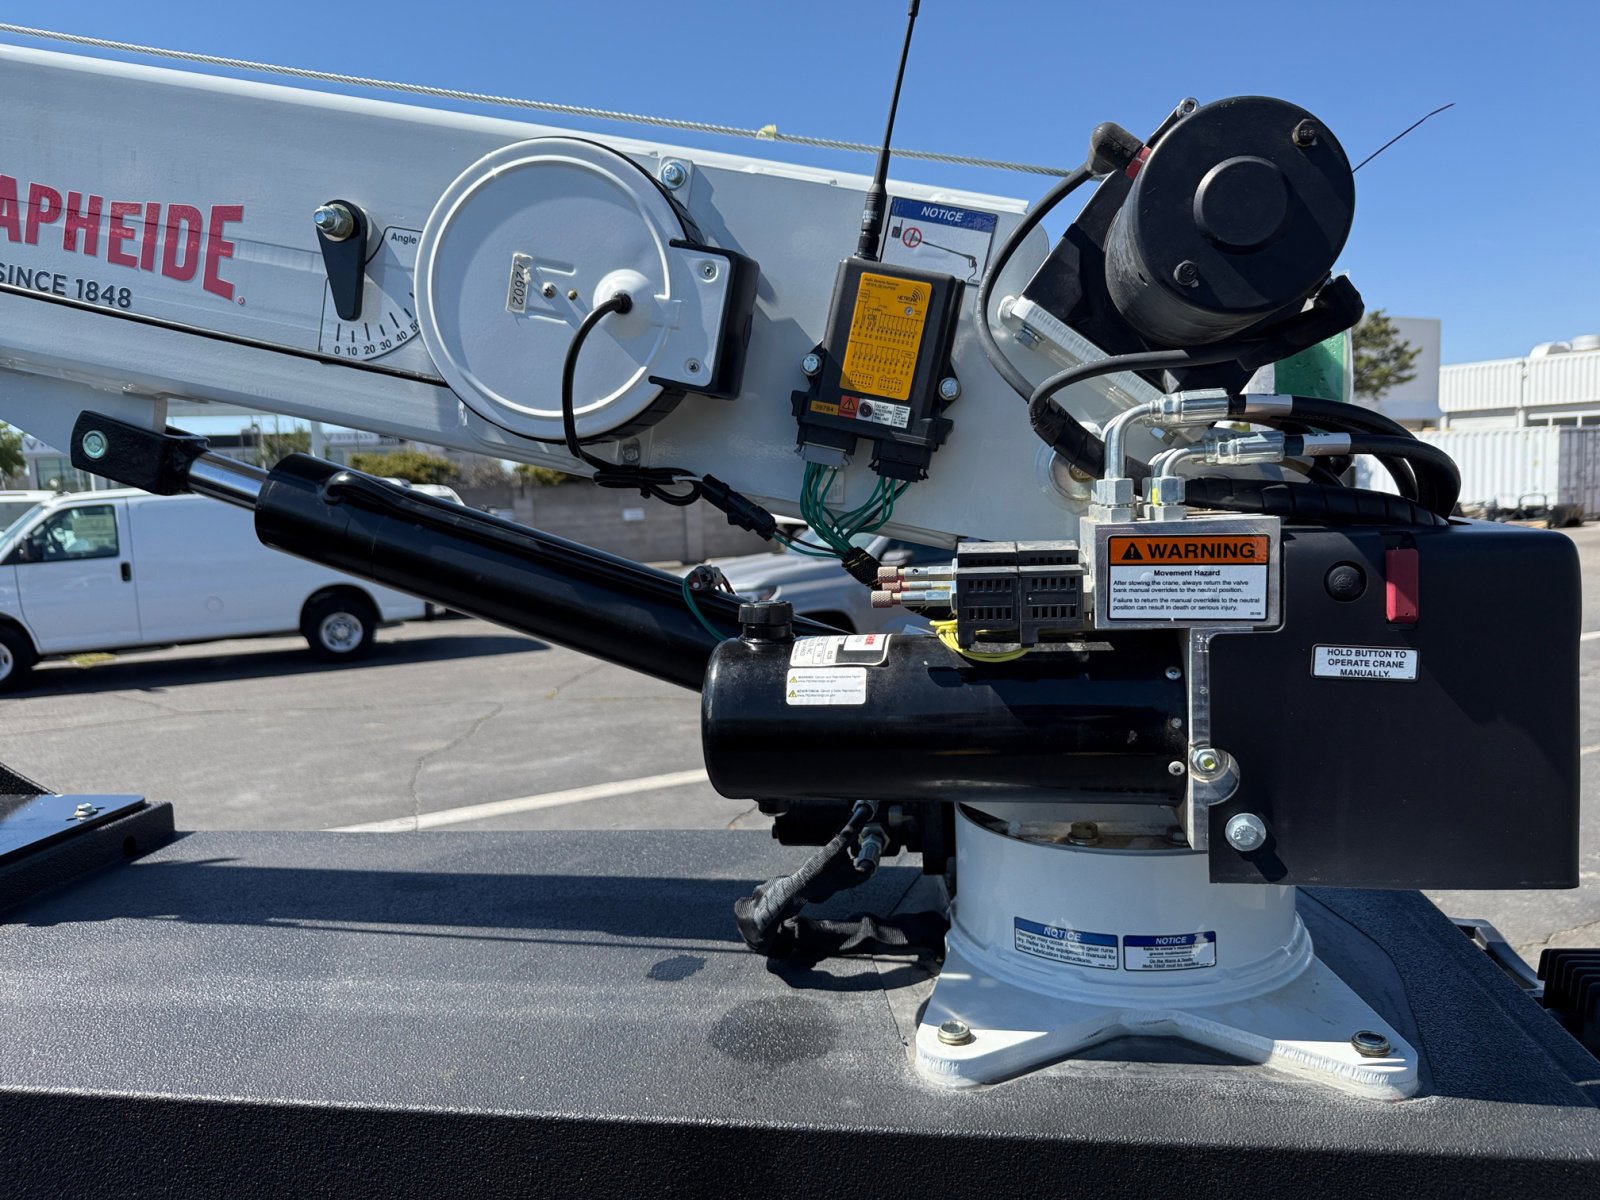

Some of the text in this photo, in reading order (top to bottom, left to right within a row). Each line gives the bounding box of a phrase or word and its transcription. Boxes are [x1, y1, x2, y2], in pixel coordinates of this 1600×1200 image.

[921, 206, 965, 222] NOTICE
[390, 232, 417, 245] Angle
[76, 279, 131, 308] 1848
[334, 346, 341, 354] 0
[346, 346, 358, 356] 10
[363, 344, 376, 355] 20
[380, 339, 392, 351] 30
[396, 331, 408, 342] 40
[1146, 542, 1256, 559] WARNING
[1153, 569, 1221, 577] Movement Hazard
[1327, 648, 1407, 659] HOLD BUTTON TO
[1328, 658, 1405, 668] OPERATE CRANE
[1340, 668, 1391, 678] MANUALLY.
[1037, 936, 1048, 944] may
[1043, 927, 1082, 942] NOTICE
[1155, 936, 1187, 945] NOTICE
[1033, 947, 1059, 958] lubrication
[1047, 943, 1055, 951] the
